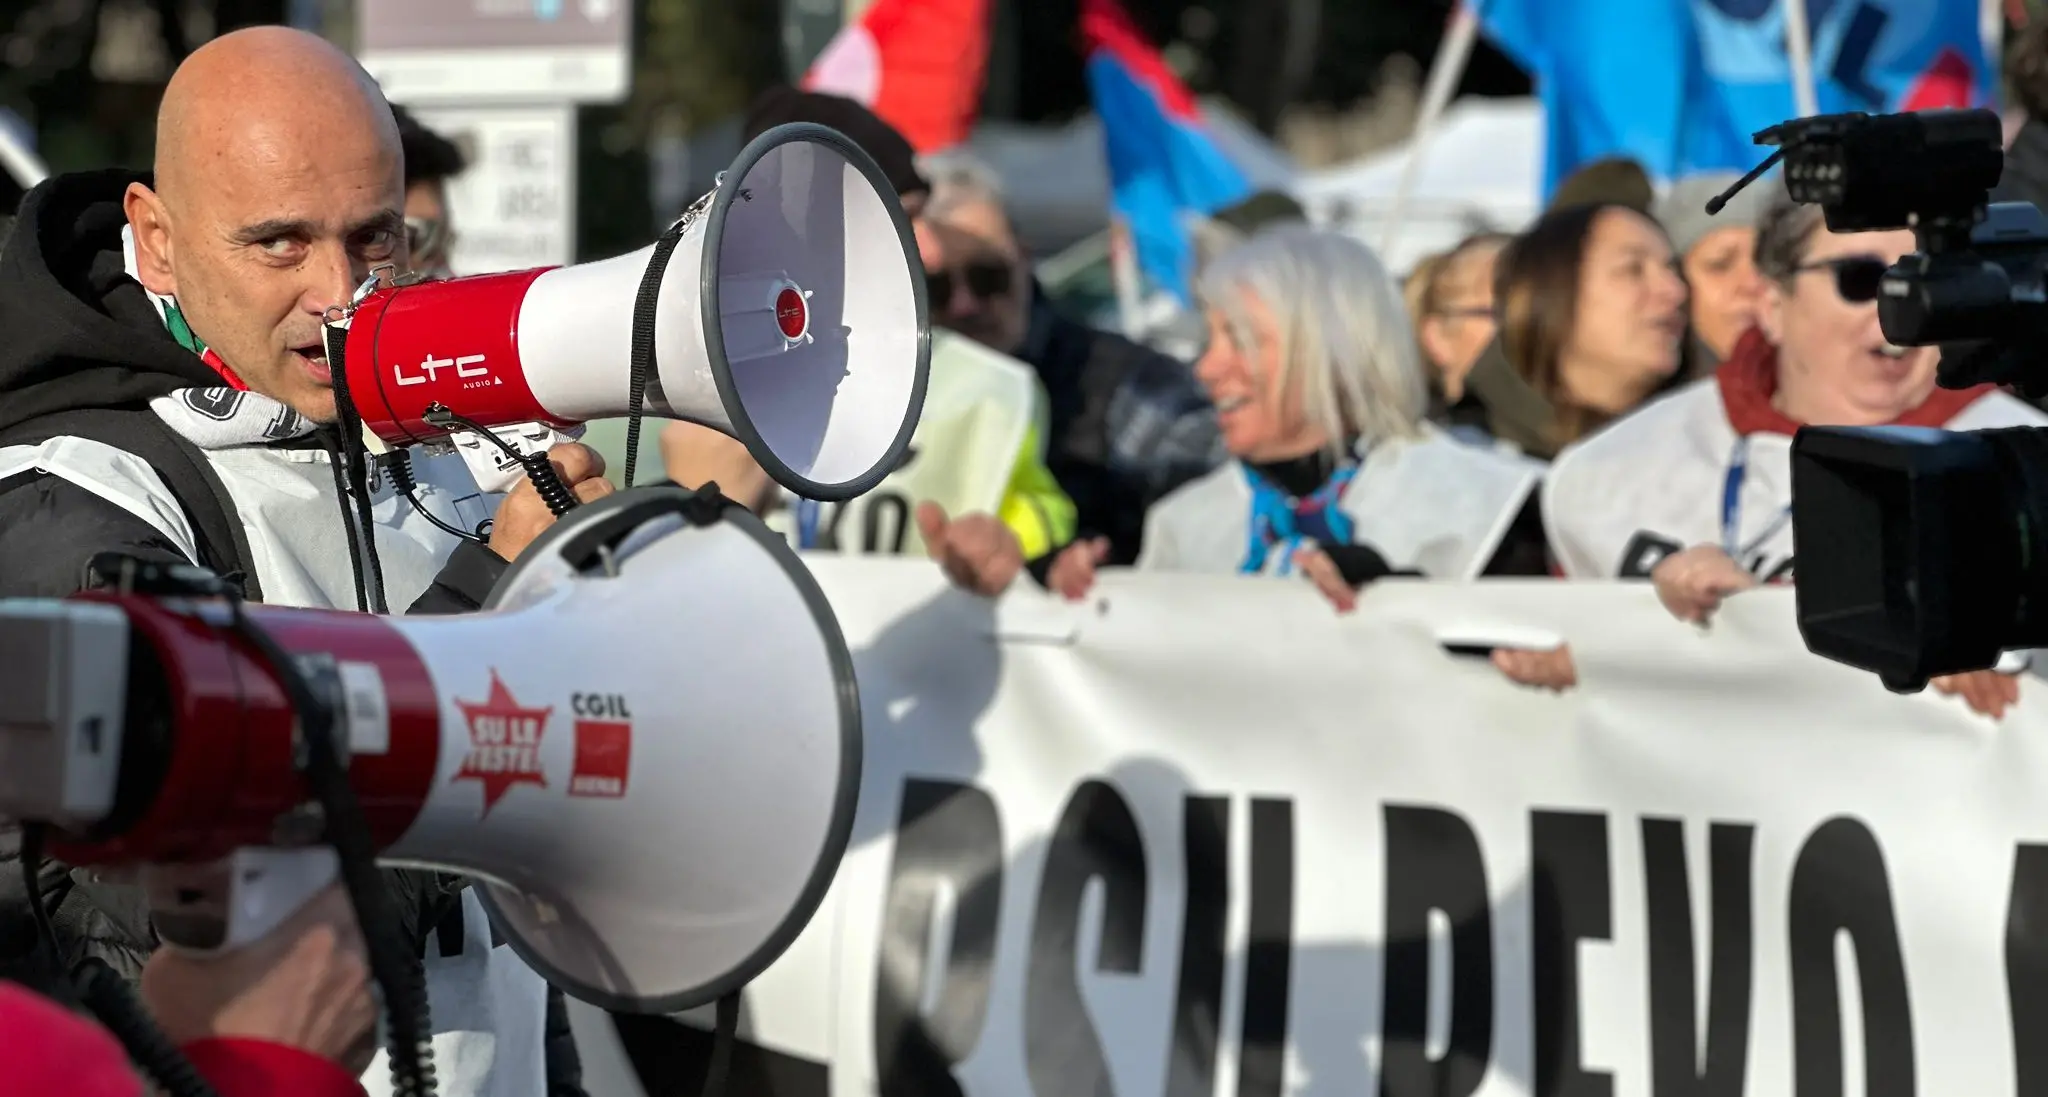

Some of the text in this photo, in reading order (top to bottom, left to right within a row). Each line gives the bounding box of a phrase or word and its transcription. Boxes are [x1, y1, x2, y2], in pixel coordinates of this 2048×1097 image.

[463, 379, 491, 389] AUDIO
[571, 692, 631, 718] CGIL
[474, 715, 539, 745] SU LE
